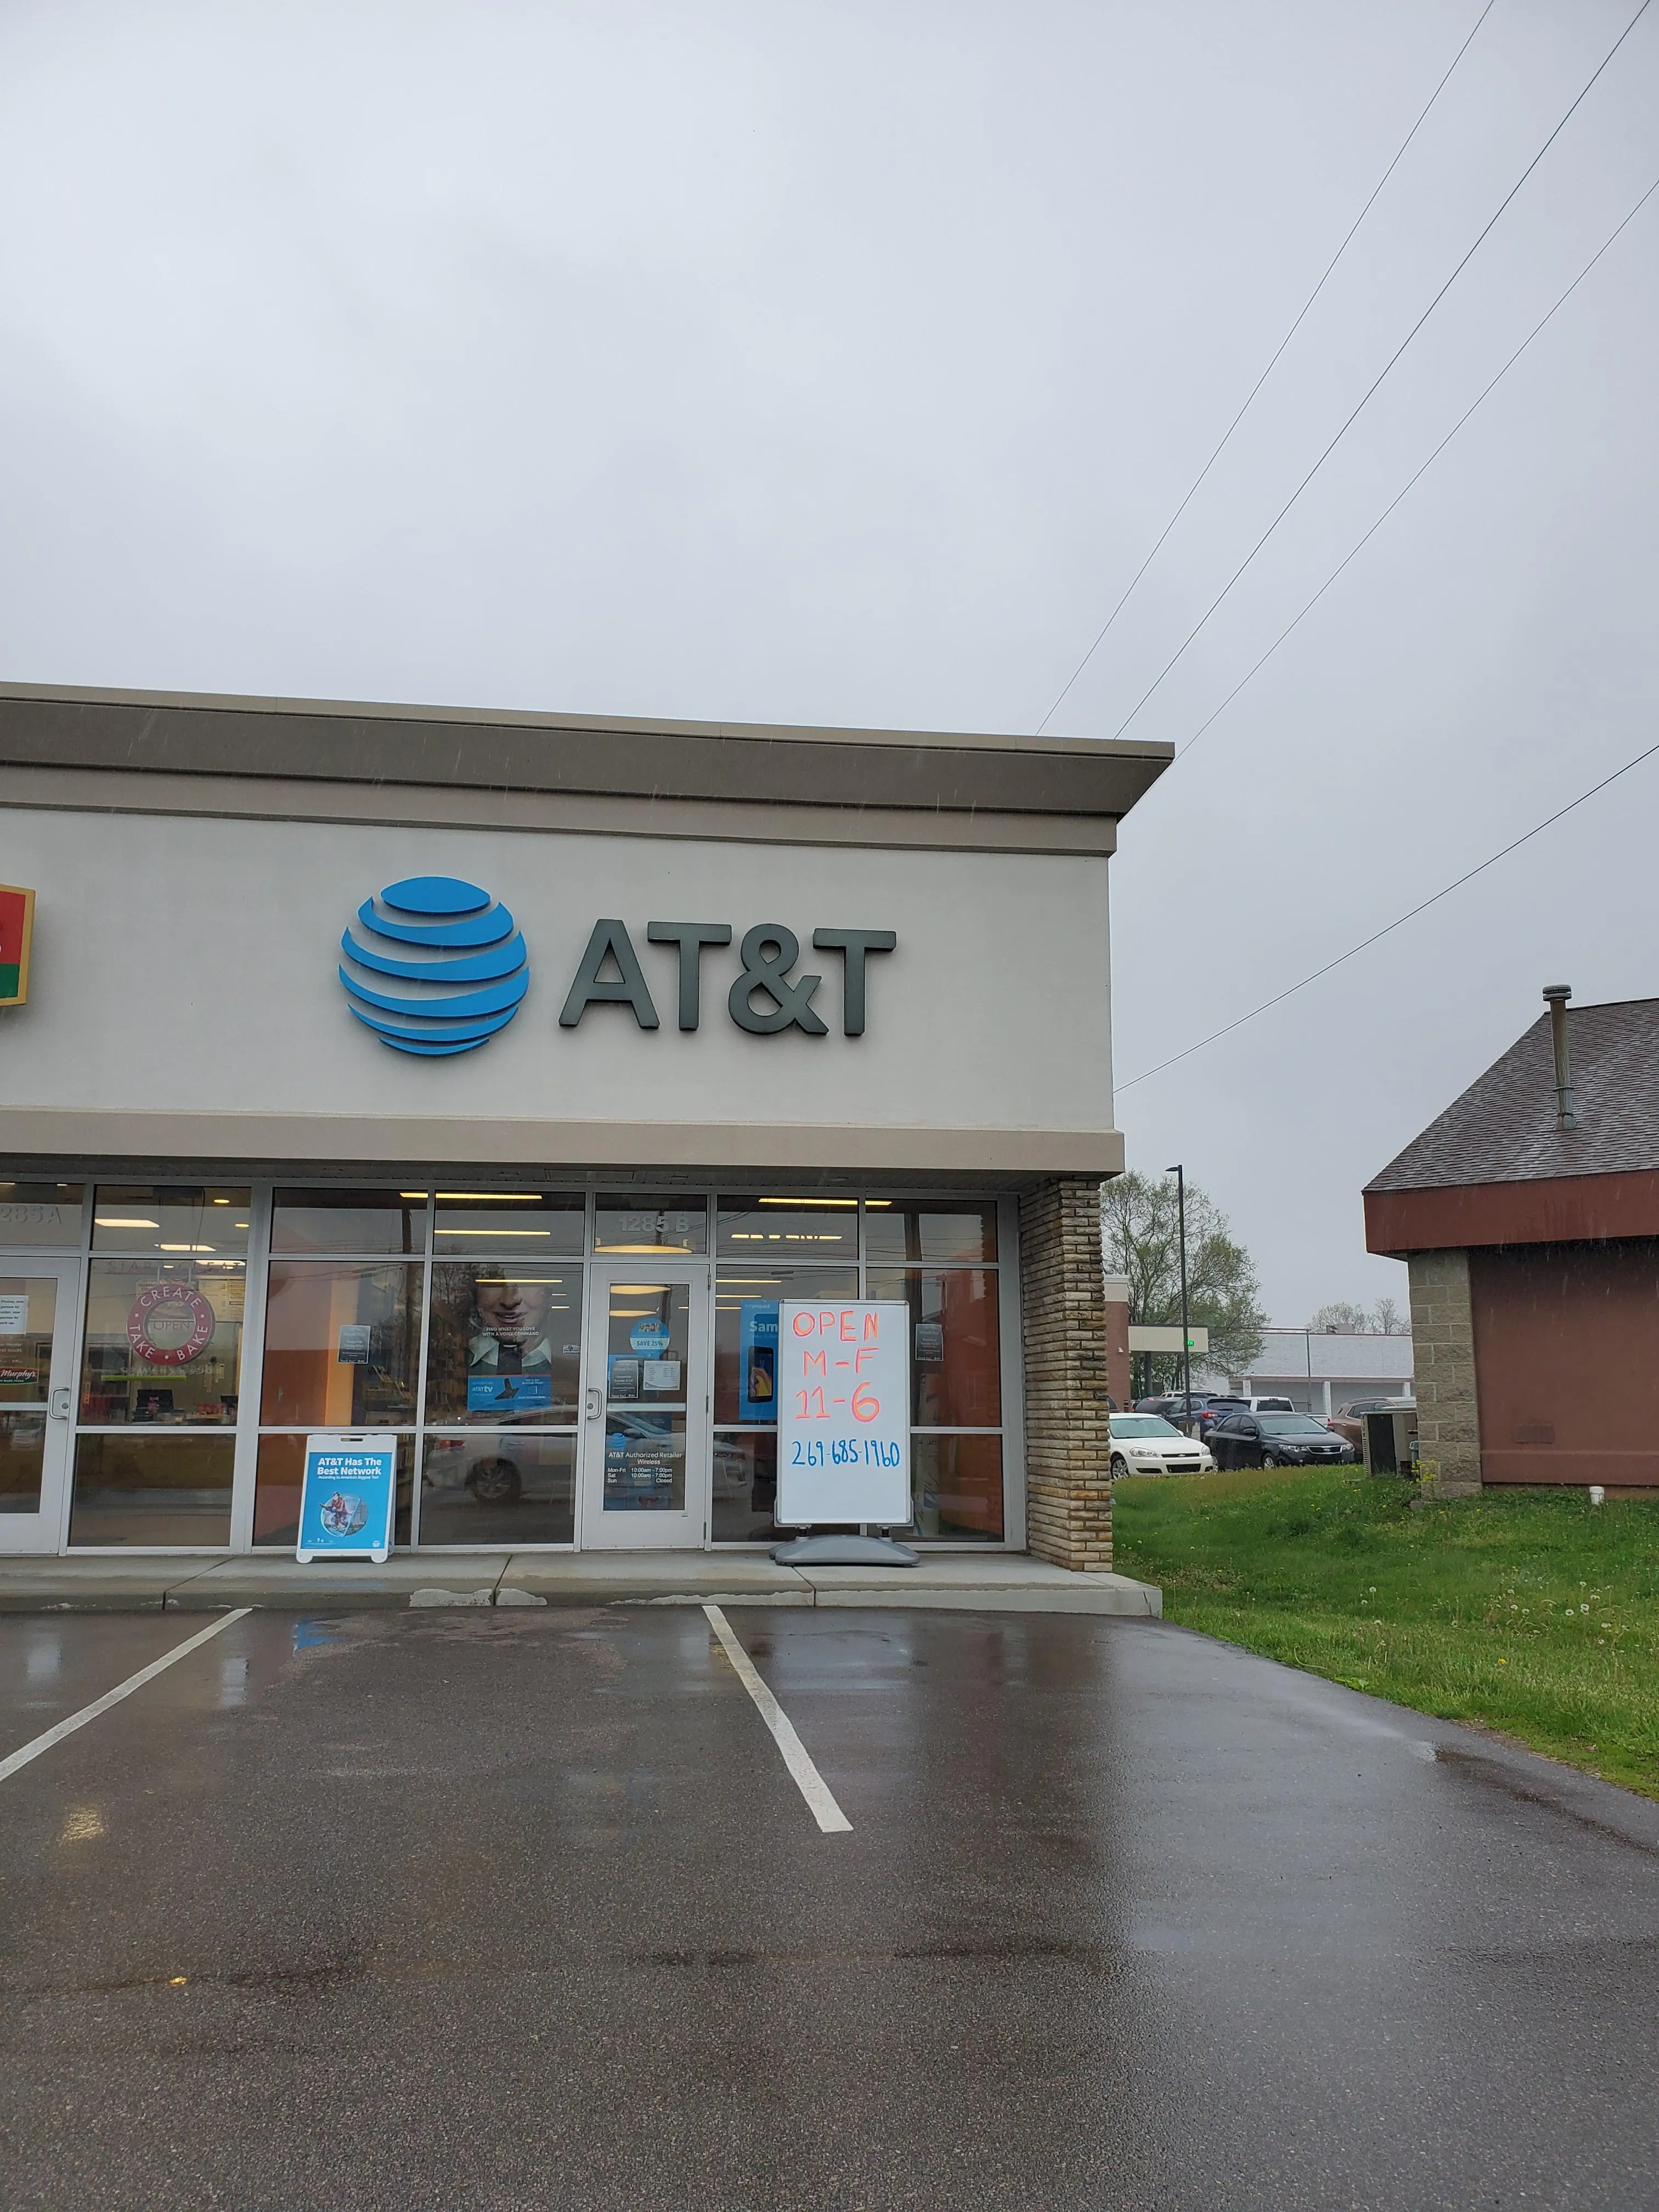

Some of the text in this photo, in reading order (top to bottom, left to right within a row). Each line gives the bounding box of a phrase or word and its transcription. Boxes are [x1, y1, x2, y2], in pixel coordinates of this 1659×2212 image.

[558, 919, 896, 1037] AT&T
[619, 1215, 689, 1233] 1285 B
[140, 1286, 201, 1308] CREATE
[154, 1321, 190, 1330] OPEN
[749, 1321, 778, 1332] Sam
[793, 1310, 879, 1342] OPEN
[129, 1324, 155, 1359] TAKE
[176, 1325, 208, 1361] BAKE
[318, 1458, 382, 1466] AT&T Has The
[791, 1438, 900, 1468] 269-685-1960
[317, 1466, 382, 1475] Best Network
